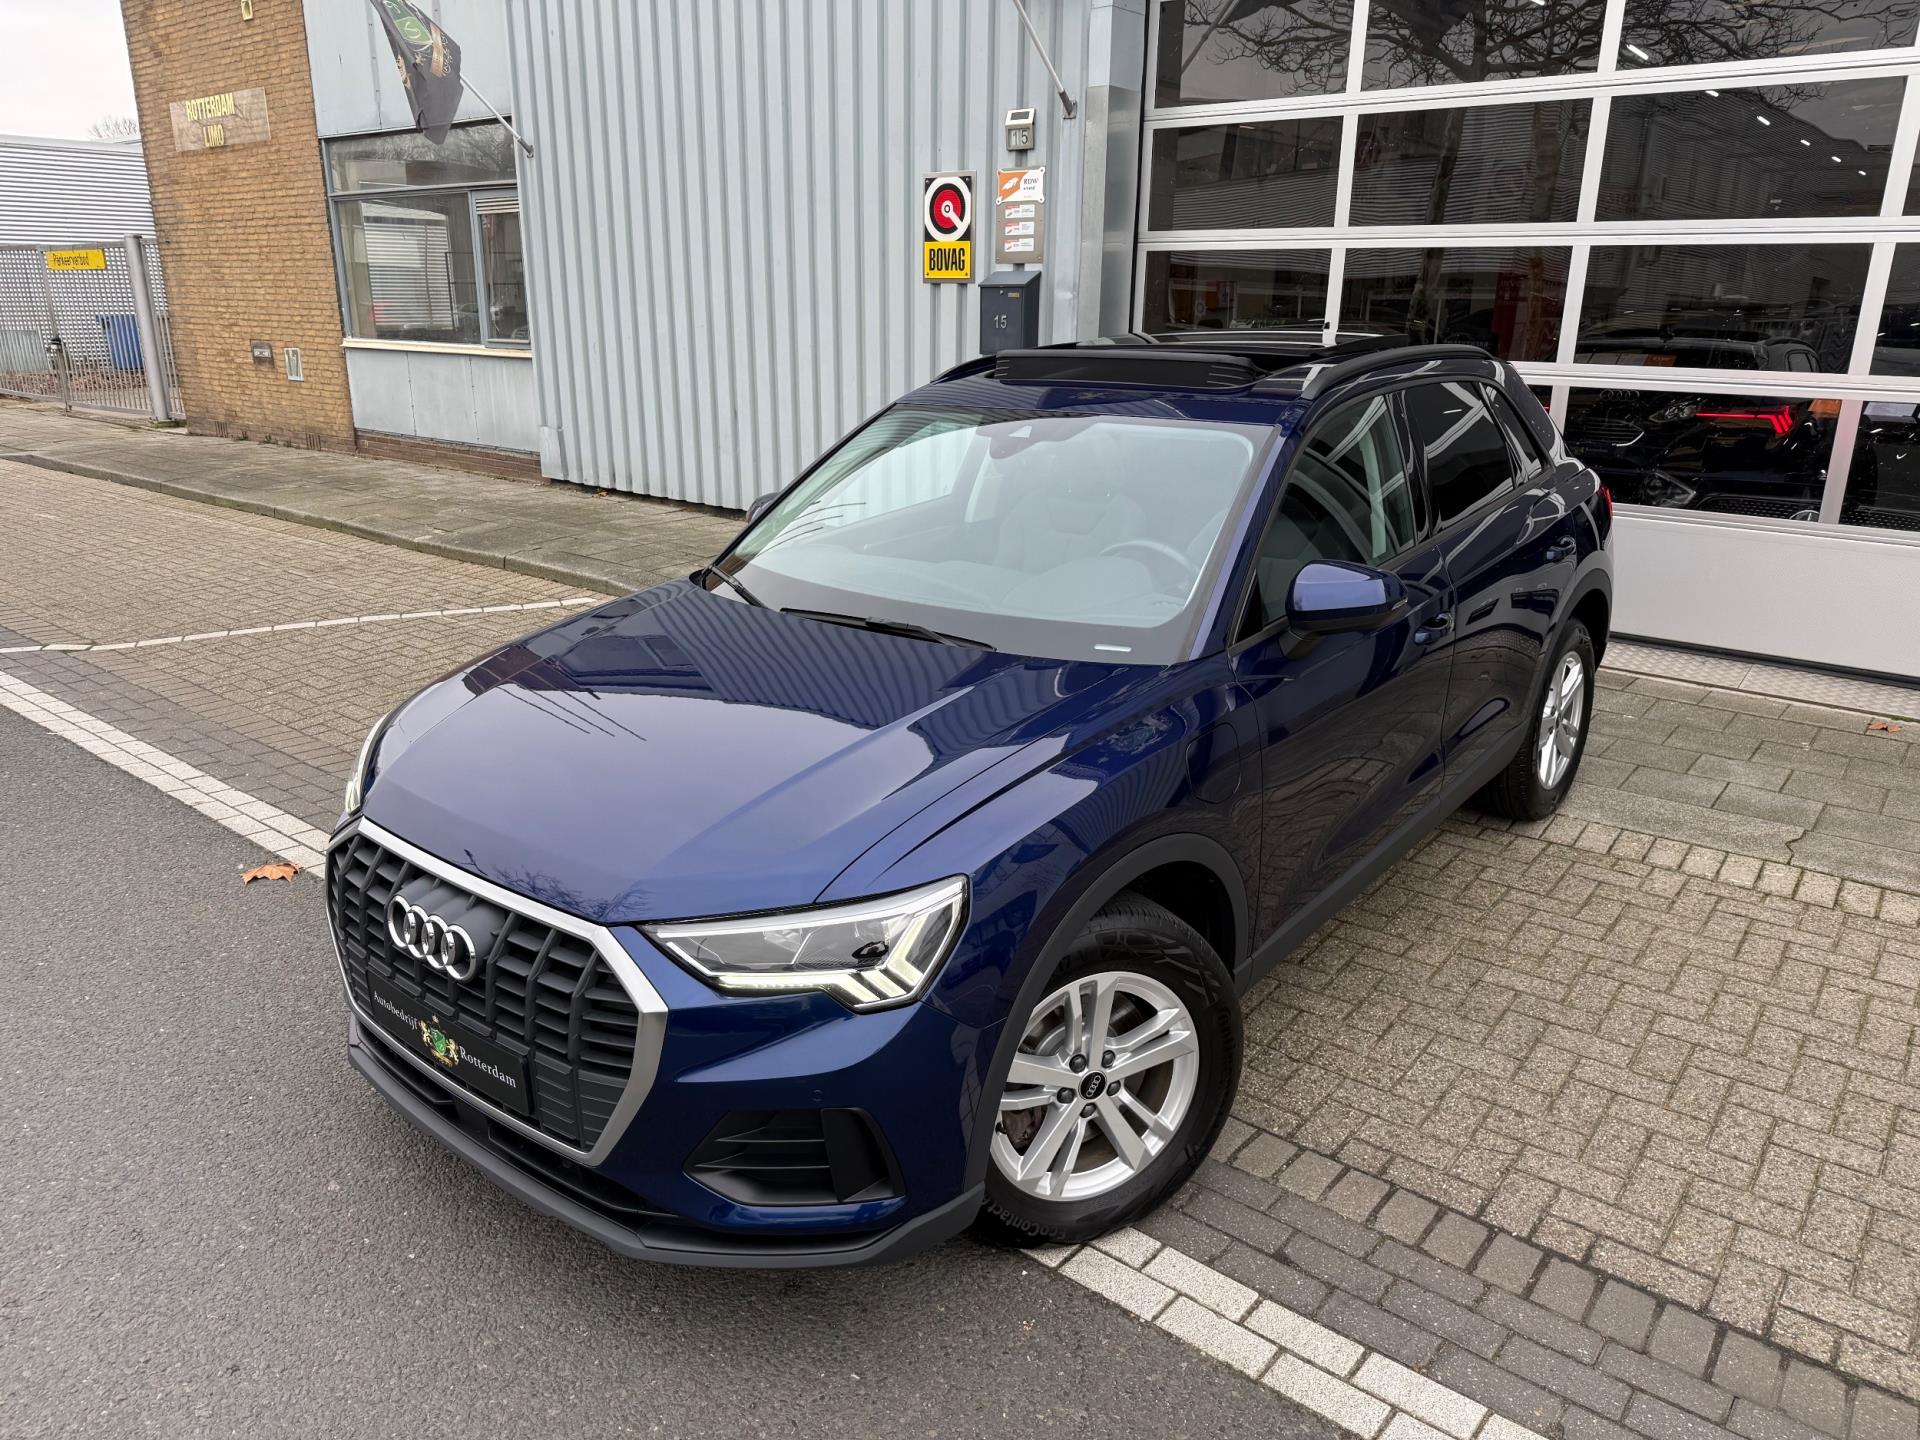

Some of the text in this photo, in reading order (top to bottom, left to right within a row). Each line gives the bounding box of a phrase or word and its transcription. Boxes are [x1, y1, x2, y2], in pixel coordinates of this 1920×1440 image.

[186, 92, 235, 121] ROTTERDAM
[203, 124, 224, 147] LIMO
[1012, 129, 1028, 145] 15
[929, 247, 965, 271] BOVAG
[993, 314, 1007, 329] 15
[374, 990, 418, 1030] Autobedrijf
[459, 1046, 516, 1088] Rotterdam
[987, 1201, 1067, 1240] EcoContact
